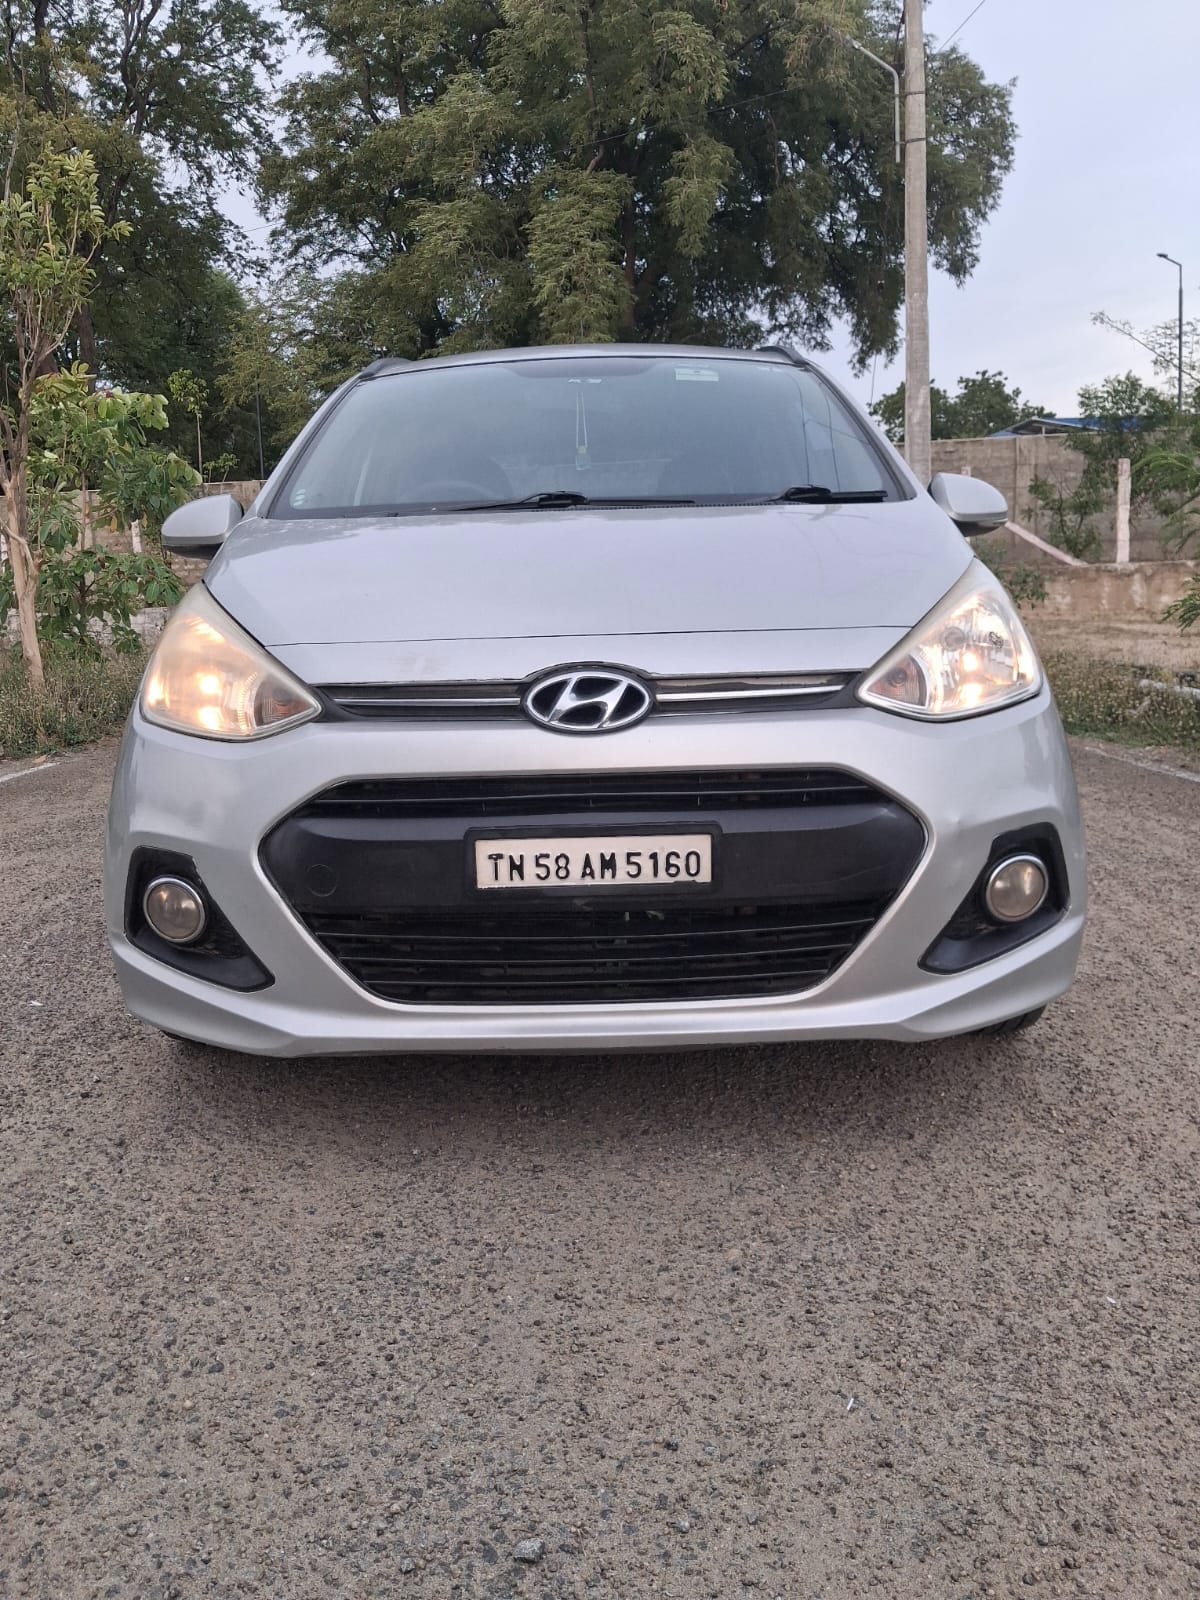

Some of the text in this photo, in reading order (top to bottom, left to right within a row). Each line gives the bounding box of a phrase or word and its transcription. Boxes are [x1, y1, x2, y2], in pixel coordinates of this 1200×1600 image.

[488, 850, 701, 881] TN 58 AM 5160
